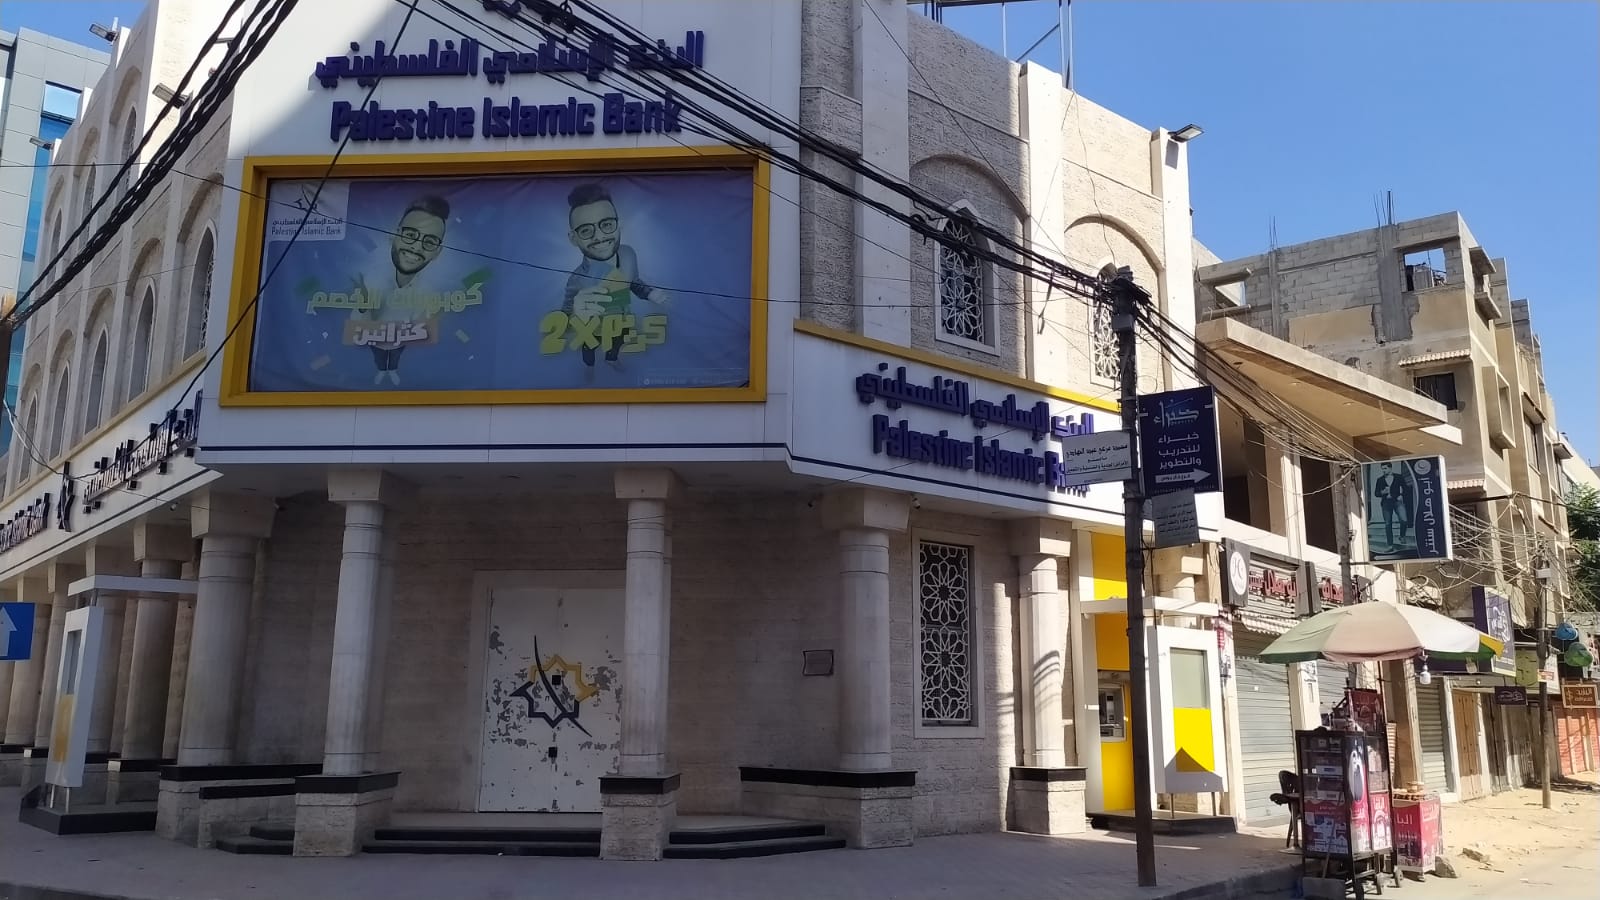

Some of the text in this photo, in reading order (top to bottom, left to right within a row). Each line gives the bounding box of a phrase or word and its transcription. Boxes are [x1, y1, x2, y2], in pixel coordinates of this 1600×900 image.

[315, 38, 478, 88] الفلسطيني
[330, 91, 683, 142] Palestine Islamic Bank
[306, 288, 381, 315] الخصم
[856, 362, 970, 416] الفلسطيني
[872, 414, 974, 470] Palestine
[974, 435, 1045, 485] Islamic
[1158, 432, 1200, 445] خبراء
[1159, 444, 1200, 458] للتدريب
[1159, 457, 1202, 470] والتطوير
[1425, 528, 1439, 554] سنتر
